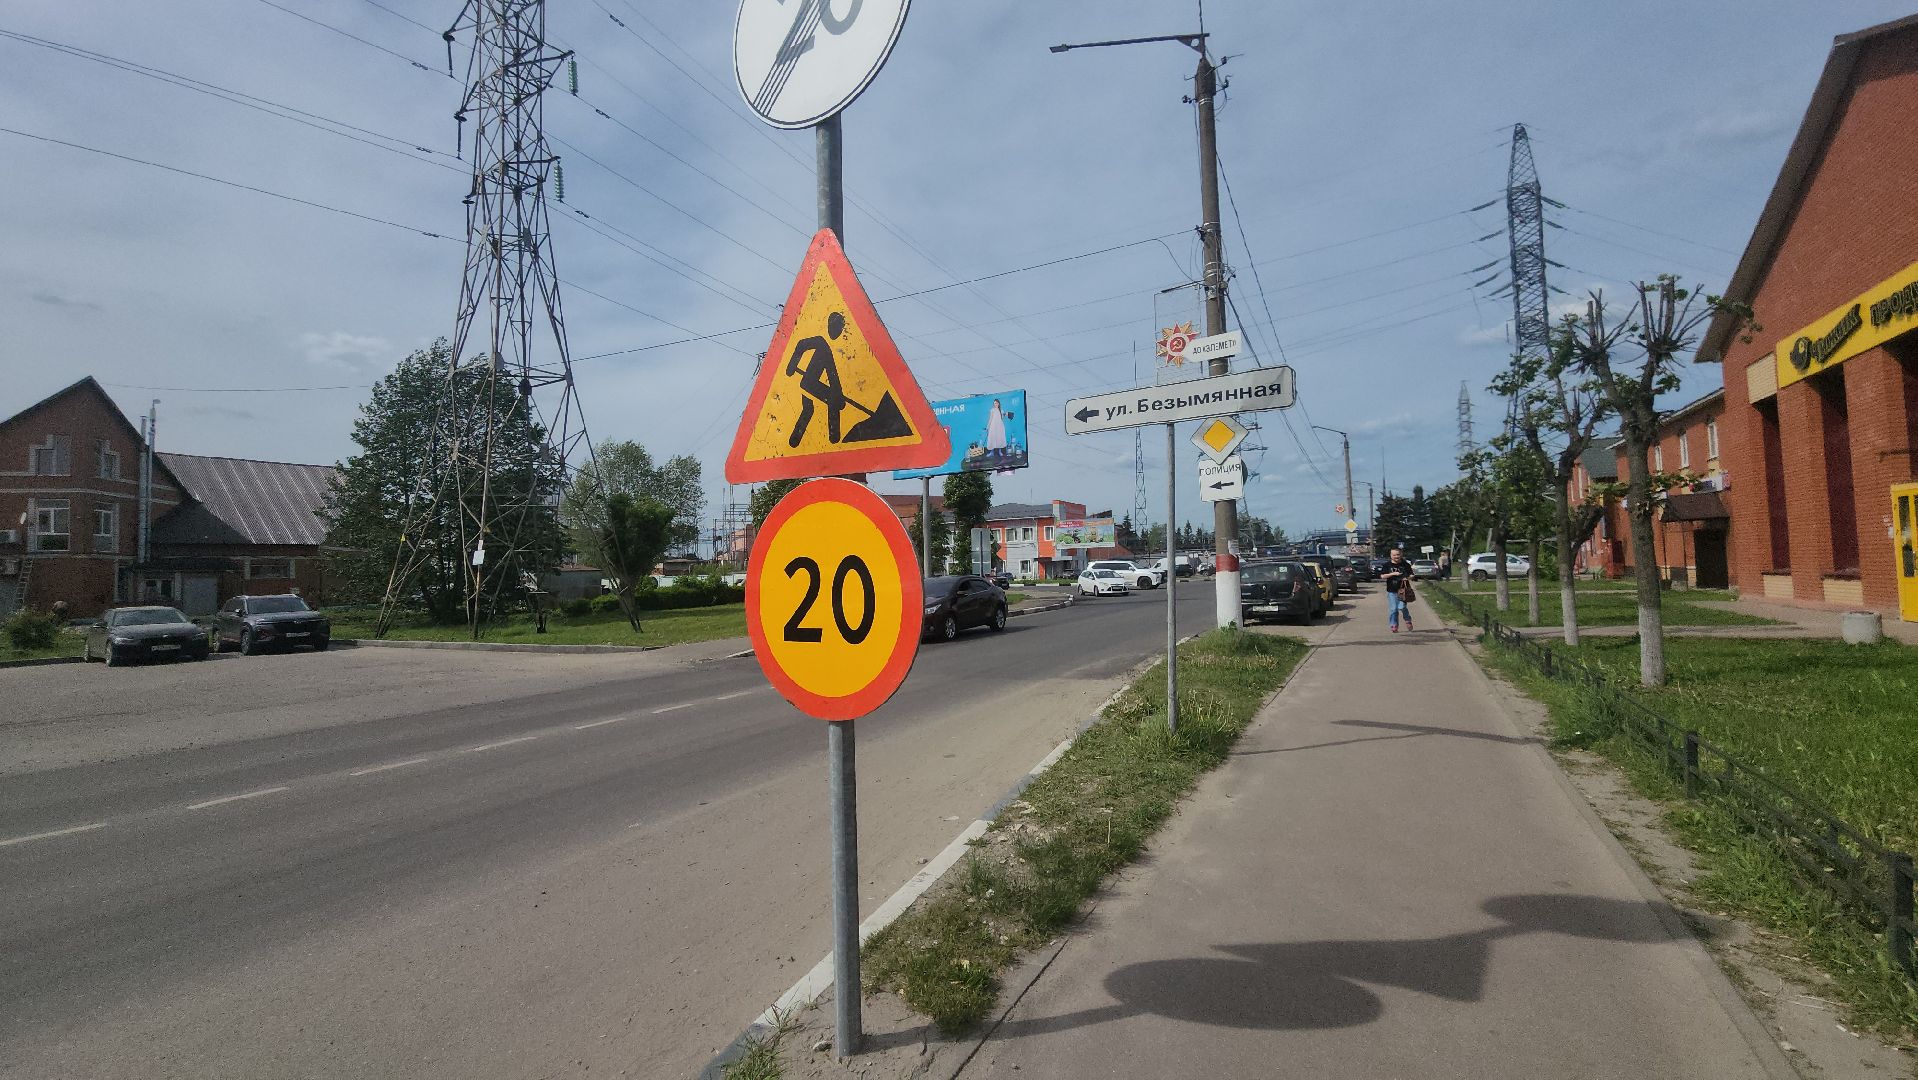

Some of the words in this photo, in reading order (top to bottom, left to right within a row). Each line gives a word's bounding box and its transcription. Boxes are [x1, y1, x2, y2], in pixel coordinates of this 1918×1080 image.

[1106, 405, 1133, 421] ул.
[1138, 382, 1281, 413] Безымянная
[784, 554, 876, 645] 20
